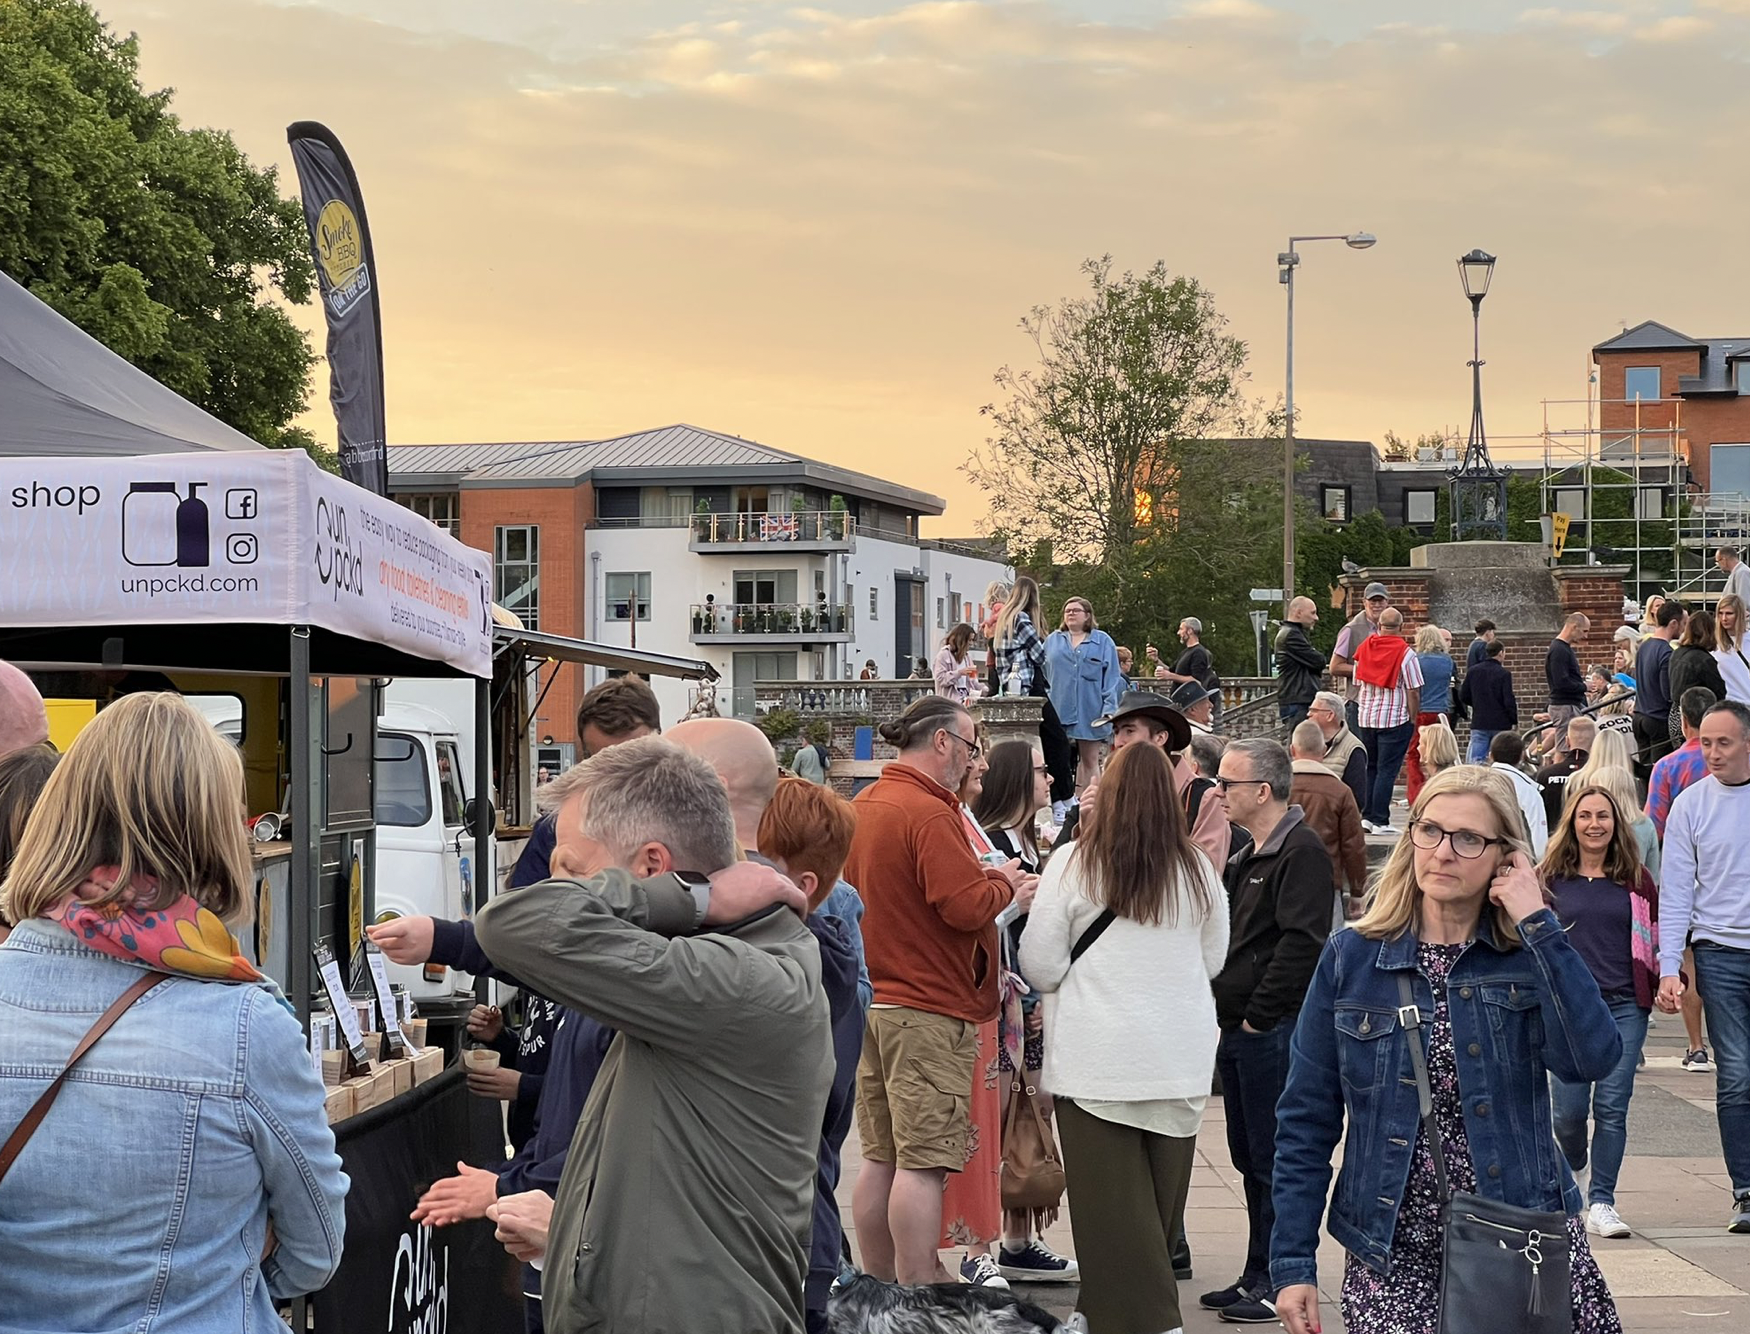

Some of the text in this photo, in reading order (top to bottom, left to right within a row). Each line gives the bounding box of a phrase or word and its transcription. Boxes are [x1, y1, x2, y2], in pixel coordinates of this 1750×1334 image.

[322, 215, 352, 260] Smoke
[336, 241, 357, 262] BBQ
[333, 271, 367, 309] ON THE GO
[11, 480, 101, 515] shop
[1556, 515, 1566, 524] Pay
[334, 535, 364, 602] pckd
[121, 572, 259, 599] unpckd.com
[1598, 717, 1632, 731] ROCK
